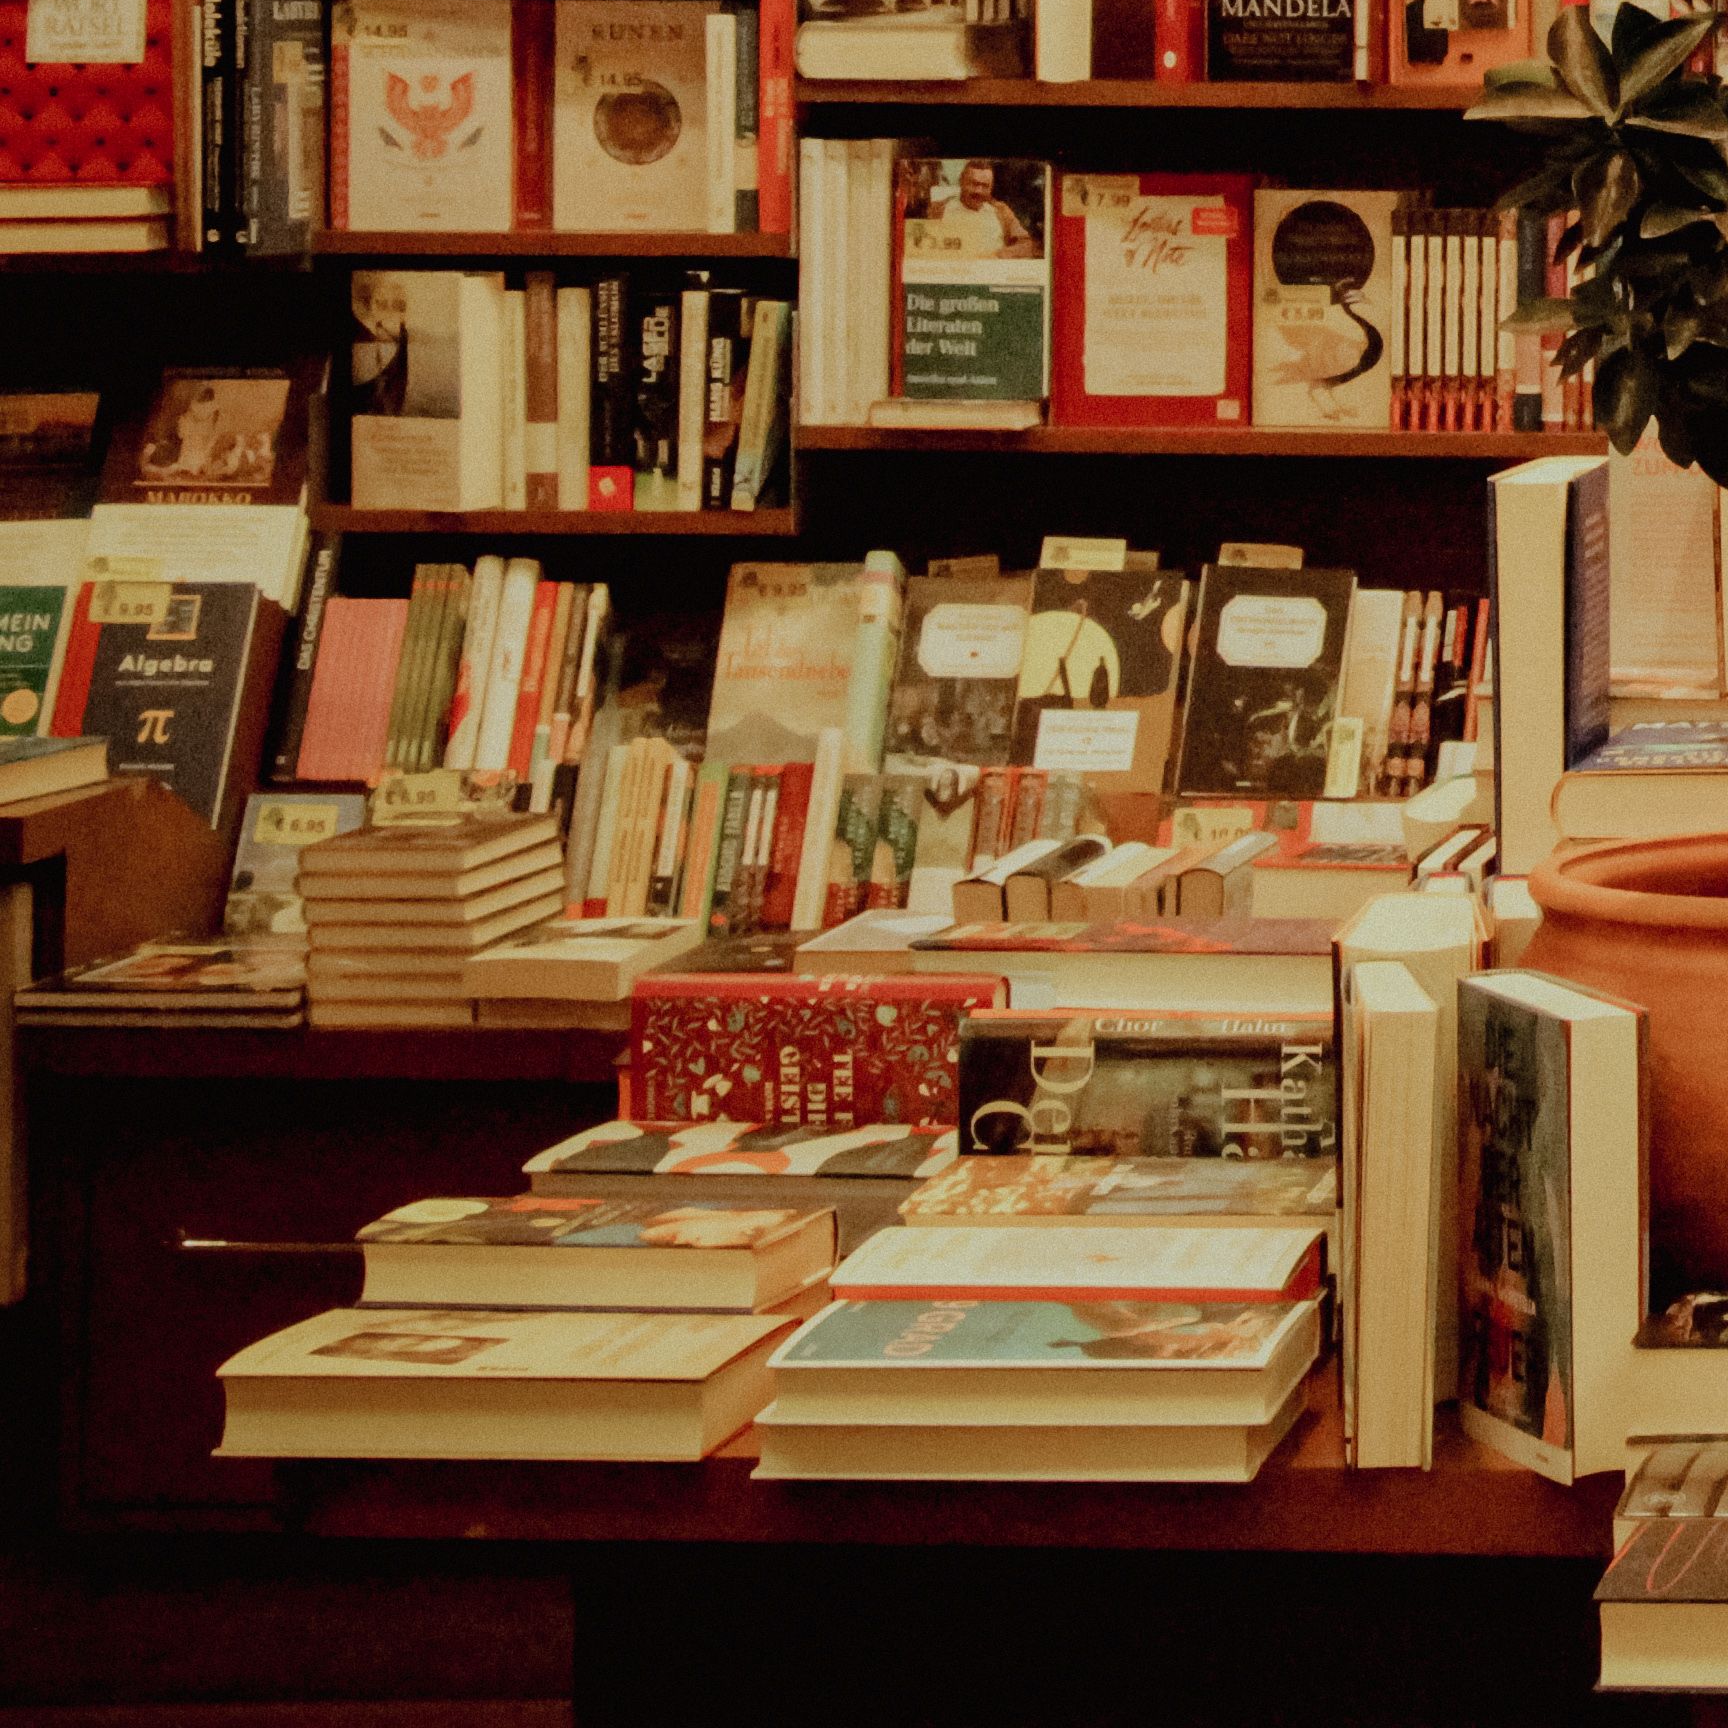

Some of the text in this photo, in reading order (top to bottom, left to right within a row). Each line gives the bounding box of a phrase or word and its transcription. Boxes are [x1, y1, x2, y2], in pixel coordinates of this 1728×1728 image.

[906, 293, 935, 313] Die
[906, 316, 982, 335] Literaten
[905, 338, 976, 356] der Welt
[122, 603, 154, 618] 9.95
[118, 654, 214, 676] Algebra
